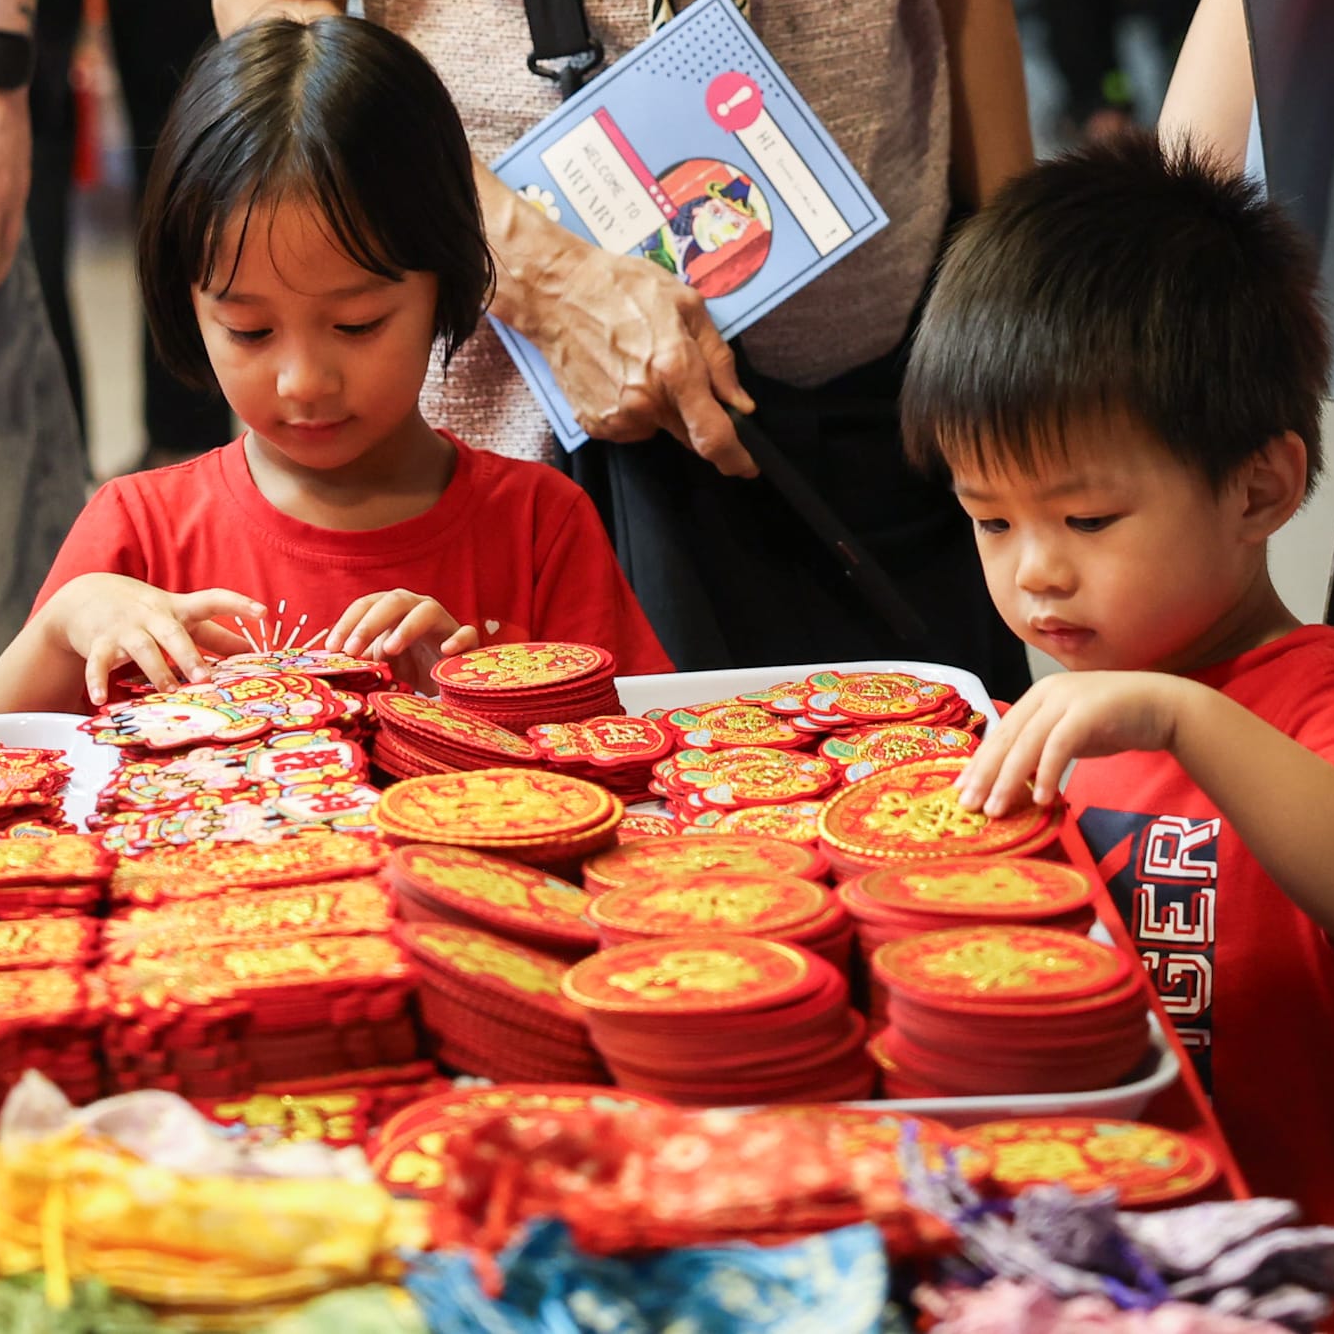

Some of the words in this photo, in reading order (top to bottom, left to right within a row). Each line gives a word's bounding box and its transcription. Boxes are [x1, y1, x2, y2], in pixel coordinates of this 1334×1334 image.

[583, 144, 625, 198] WELCOME
[624, 201, 641, 219] TO
[1132, 815, 1221, 1050] GER
